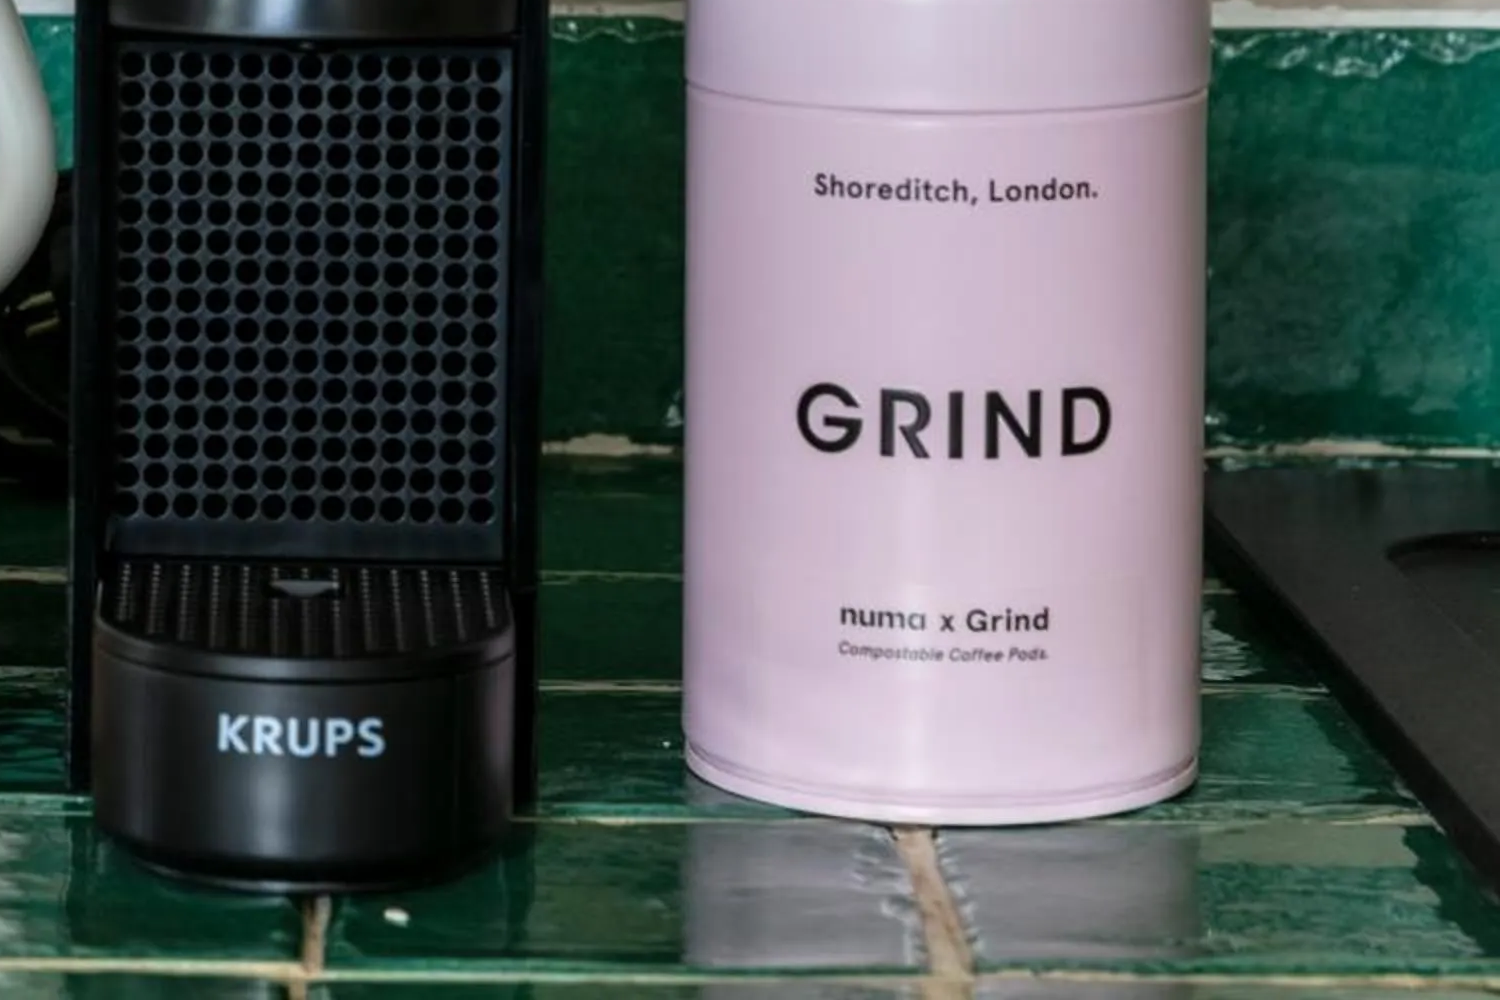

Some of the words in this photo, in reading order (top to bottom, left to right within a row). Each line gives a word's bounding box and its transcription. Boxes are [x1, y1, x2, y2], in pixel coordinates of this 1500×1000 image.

[813, 172, 978, 206] Shoreditch,
[989, 177, 1098, 203] London.
[796, 382, 1112, 460] GRIND
[840, 606, 927, 631] numa
[940, 614, 955, 632] x
[966, 607, 1050, 632] Grind
[838, 641, 945, 662] Compostable
[949, 648, 1005, 663] Coffee
[217, 713, 386, 758] KRUPS
